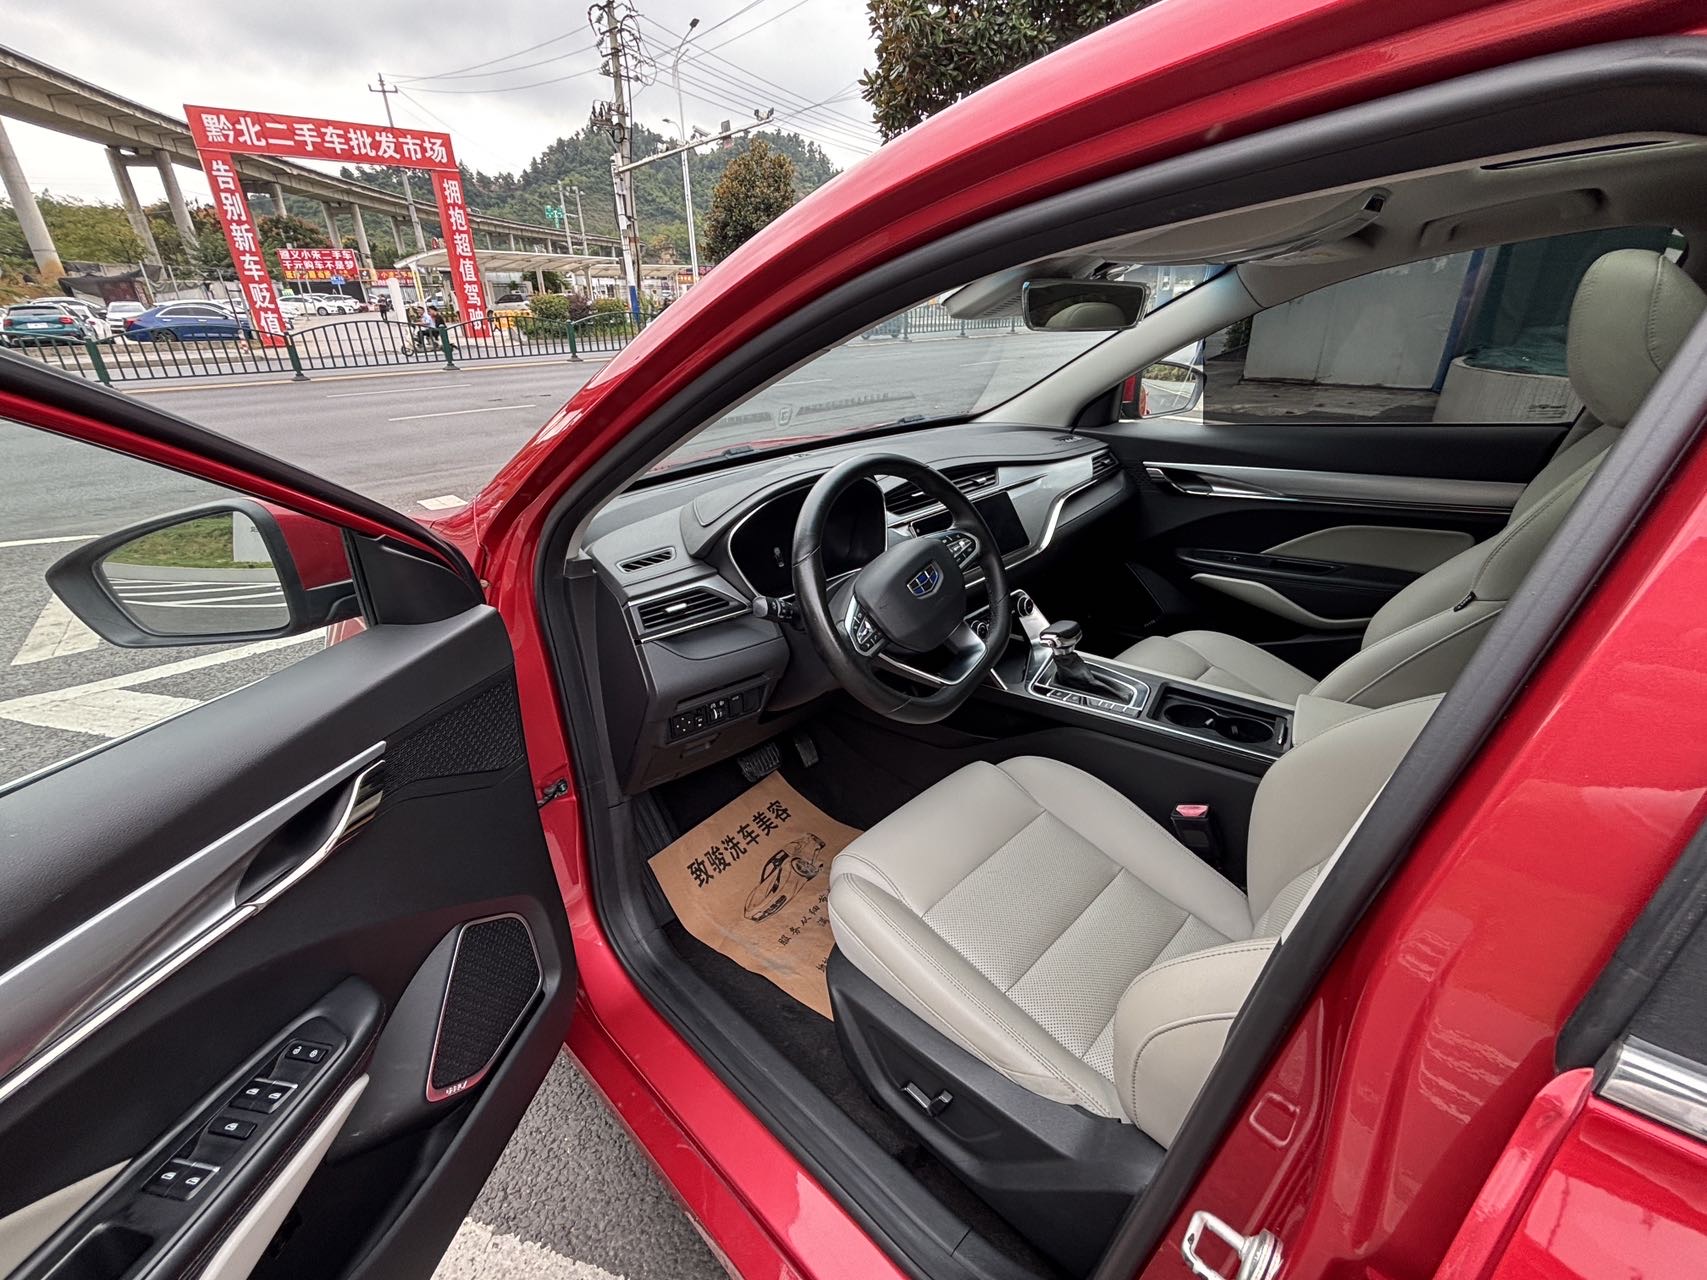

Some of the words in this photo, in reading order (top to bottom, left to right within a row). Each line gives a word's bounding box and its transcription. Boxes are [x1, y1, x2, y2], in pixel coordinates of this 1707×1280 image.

[201, 113, 448, 164] 黔北二手车批发市场
[211, 160, 285, 337] 告别新车贬值
[443, 178, 486, 330] 拥抱超值驾驶
[687, 800, 792, 888] 致骏洗车美容
